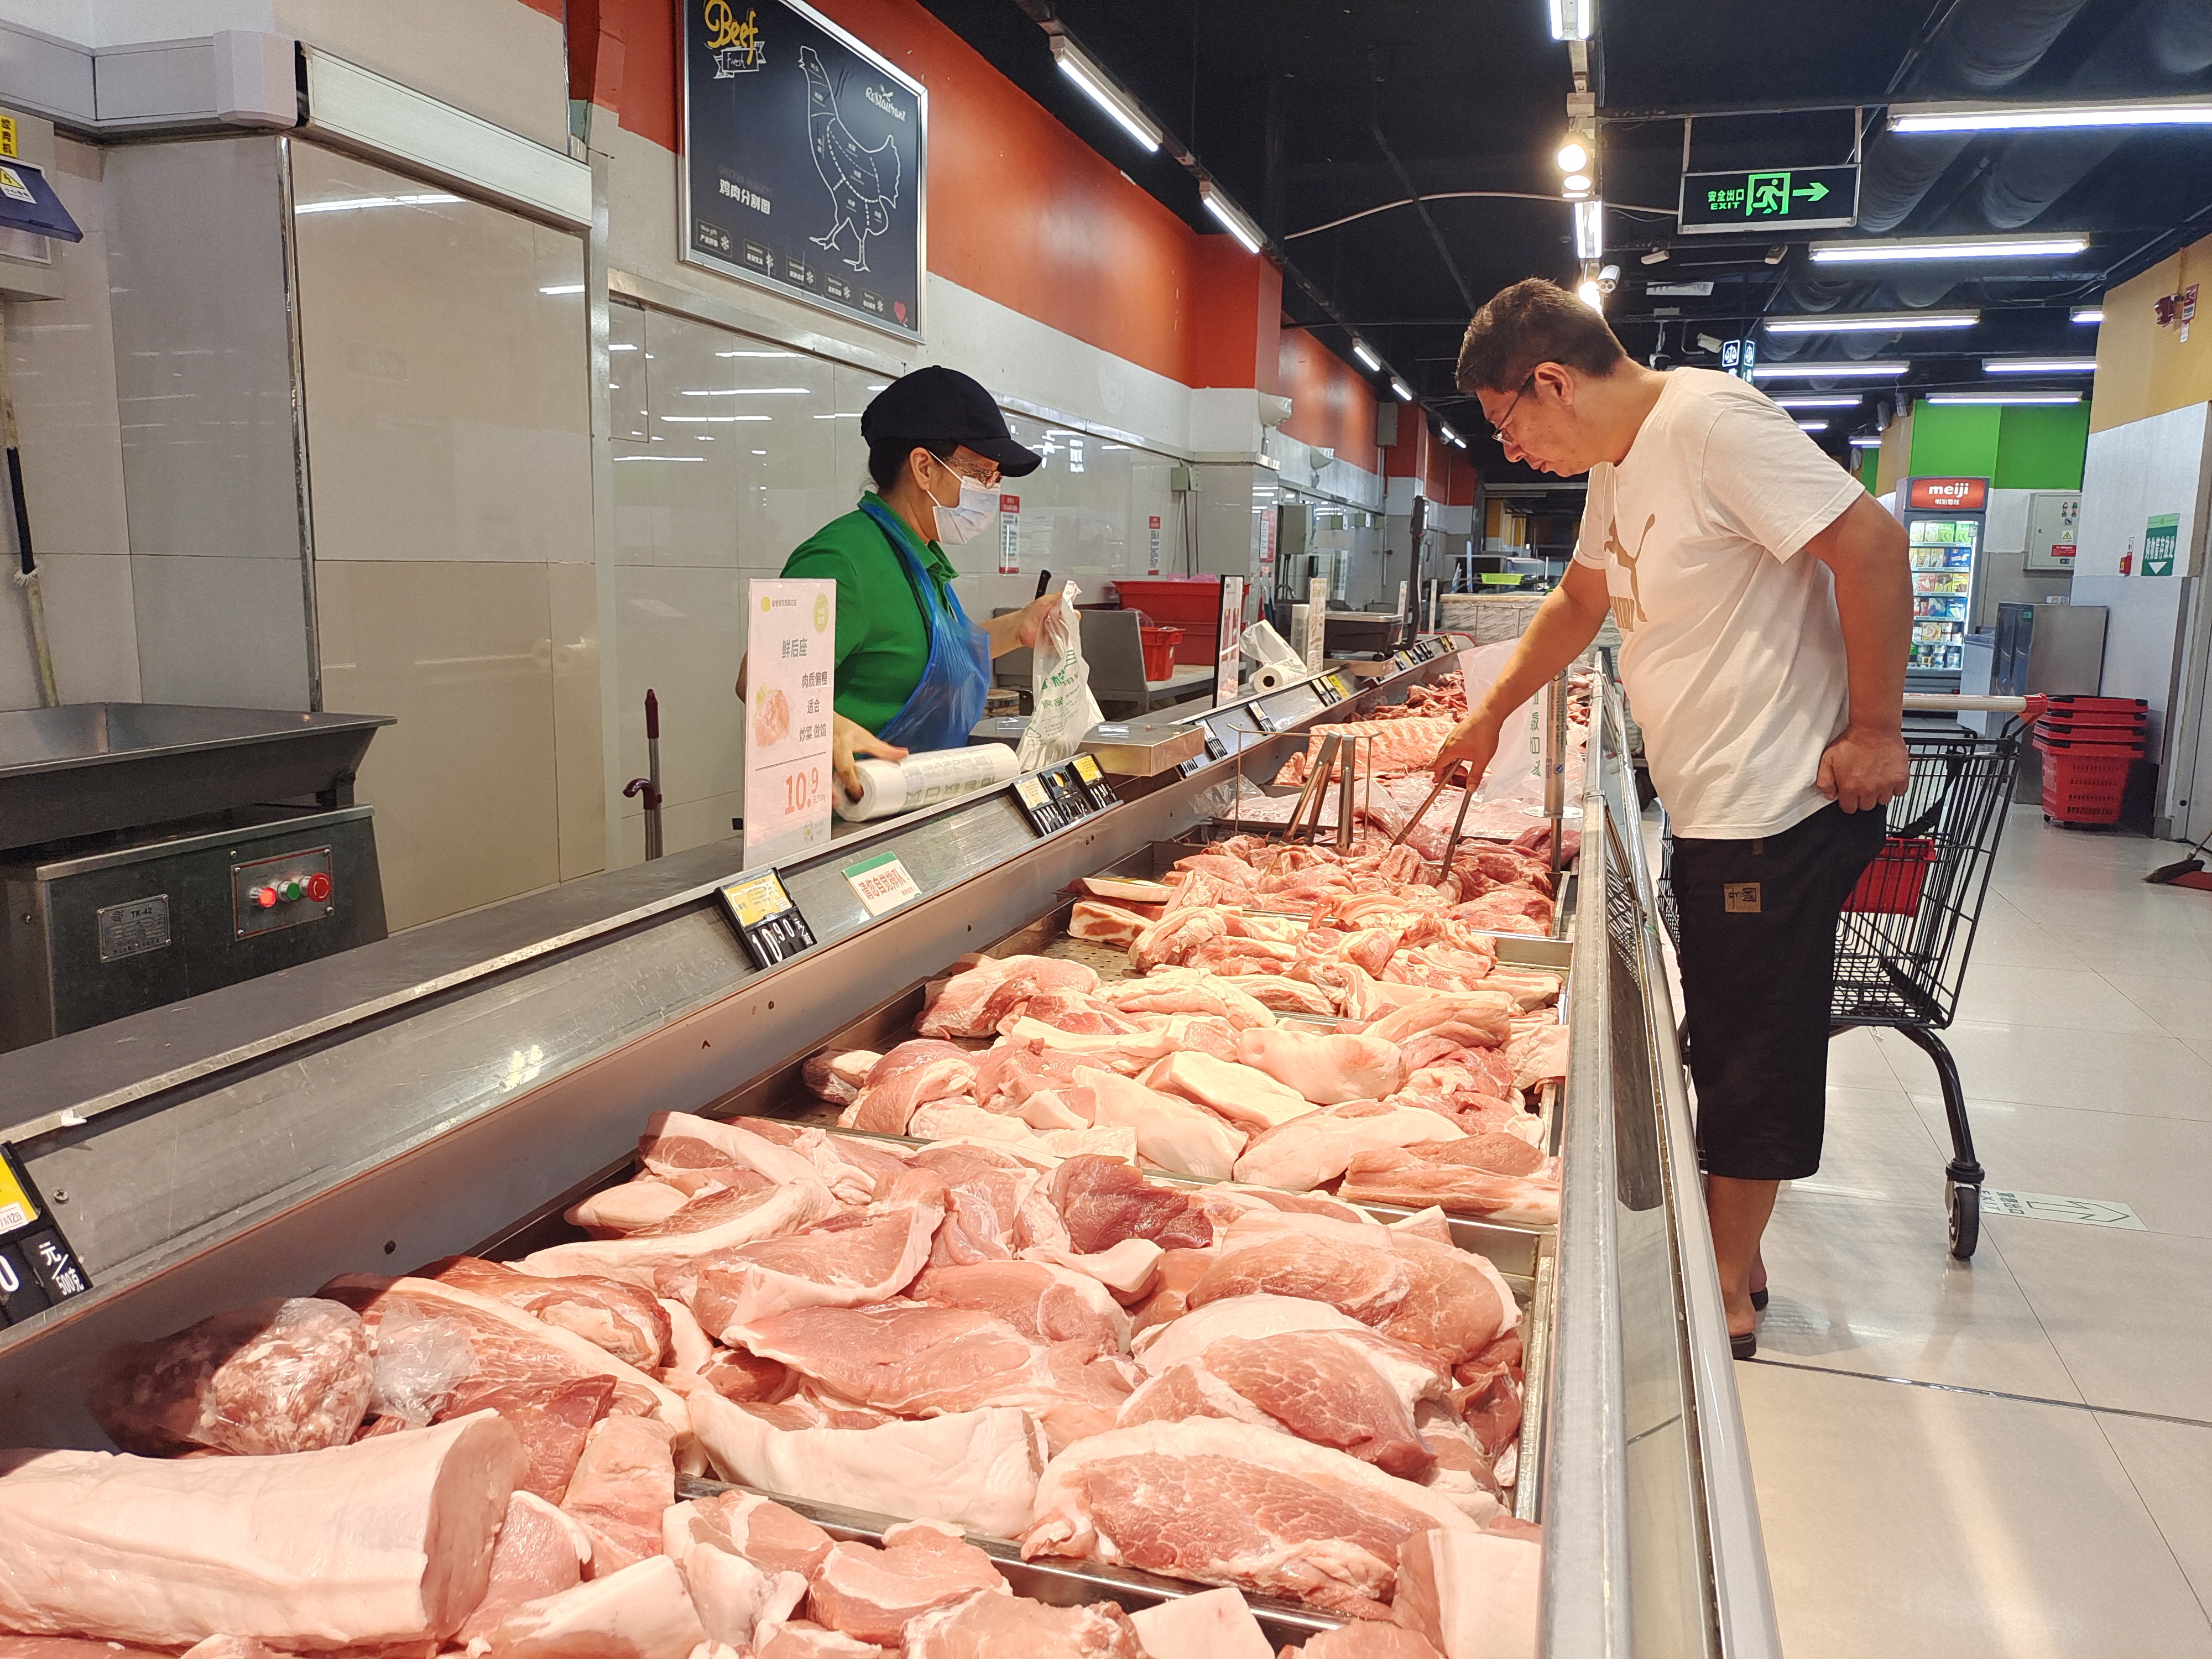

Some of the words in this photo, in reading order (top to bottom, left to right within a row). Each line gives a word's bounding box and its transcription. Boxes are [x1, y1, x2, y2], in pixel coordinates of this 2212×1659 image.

[705, 0, 759, 65] Beef
[719, 179, 771, 215] 鸡肉分割图
[1708, 189, 1744, 202] 安全出口
[1710, 202, 1740, 210] EXIT
[1928, 482, 1969, 498] meiji
[782, 638, 807, 659] 鲜后座
[807, 698, 820, 714] 适合
[785, 766, 818, 815] 10.9
[752, 919, 795, 967] 10.90
